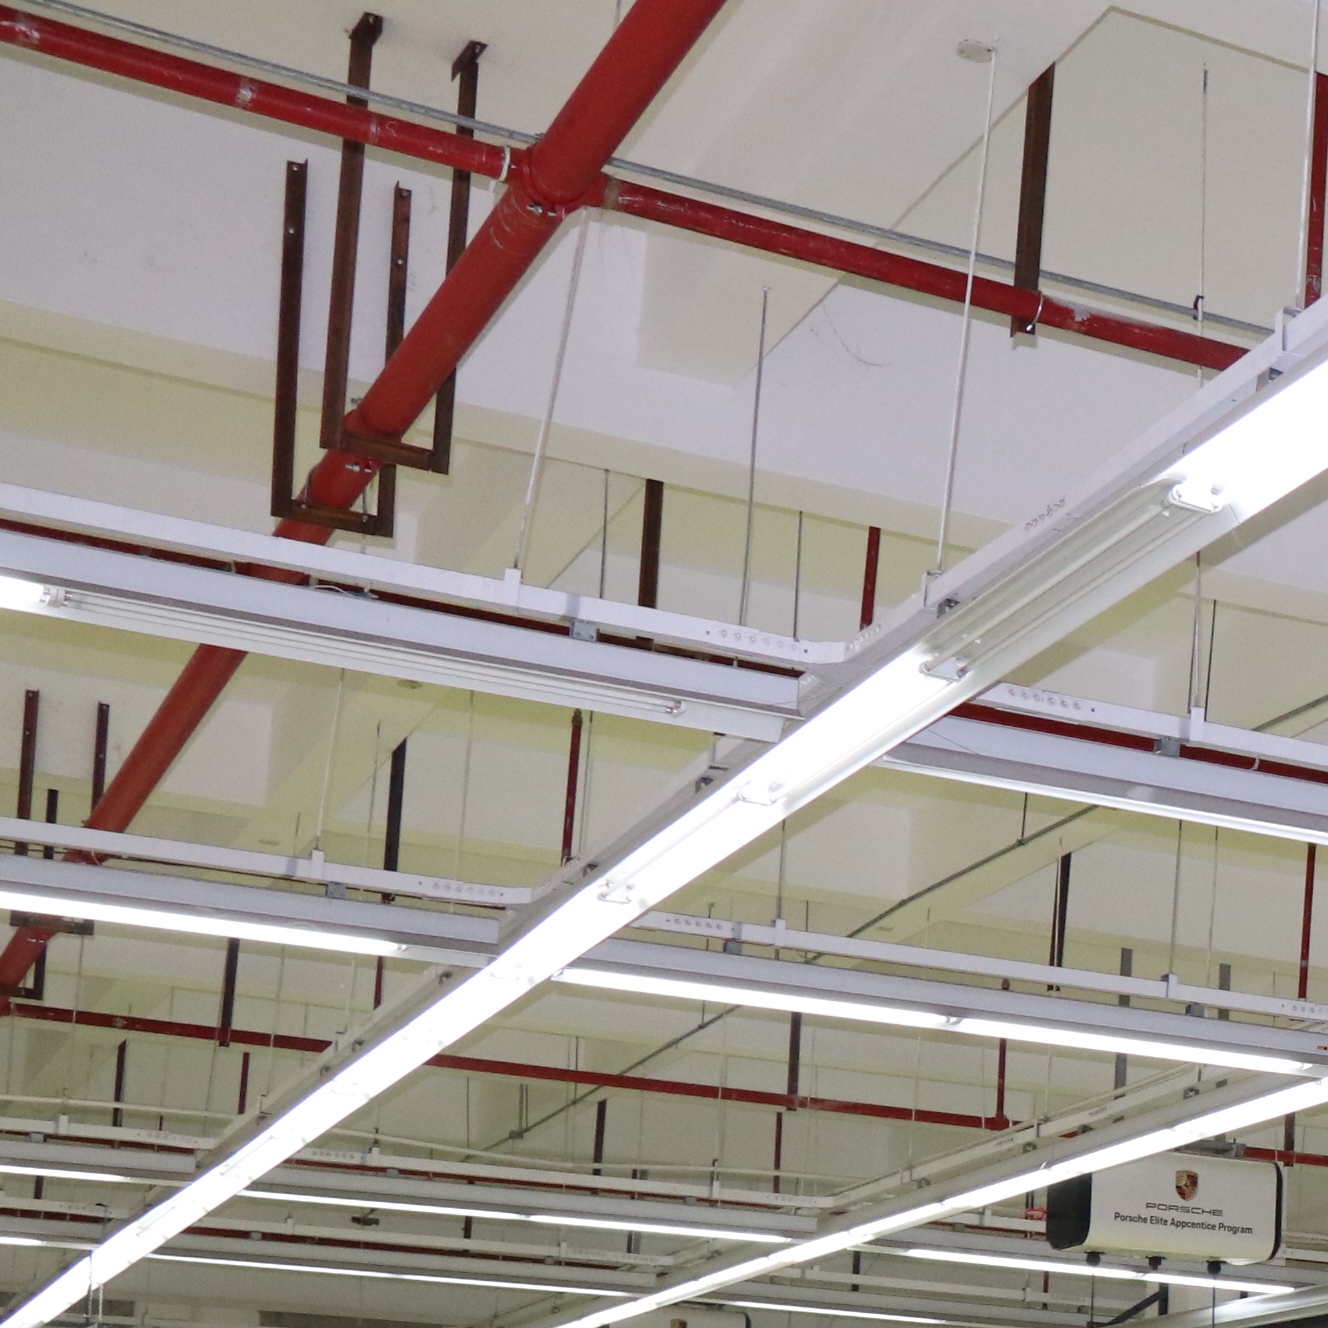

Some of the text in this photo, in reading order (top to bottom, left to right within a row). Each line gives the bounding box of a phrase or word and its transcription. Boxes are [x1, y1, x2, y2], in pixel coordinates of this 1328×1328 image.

[1145, 1202, 1223, 1217] PORSCHE
[1114, 1212, 1148, 1224] Porsche
[1150, 1215, 1168, 1226] Elite
[1218, 1222, 1253, 1235] Program
